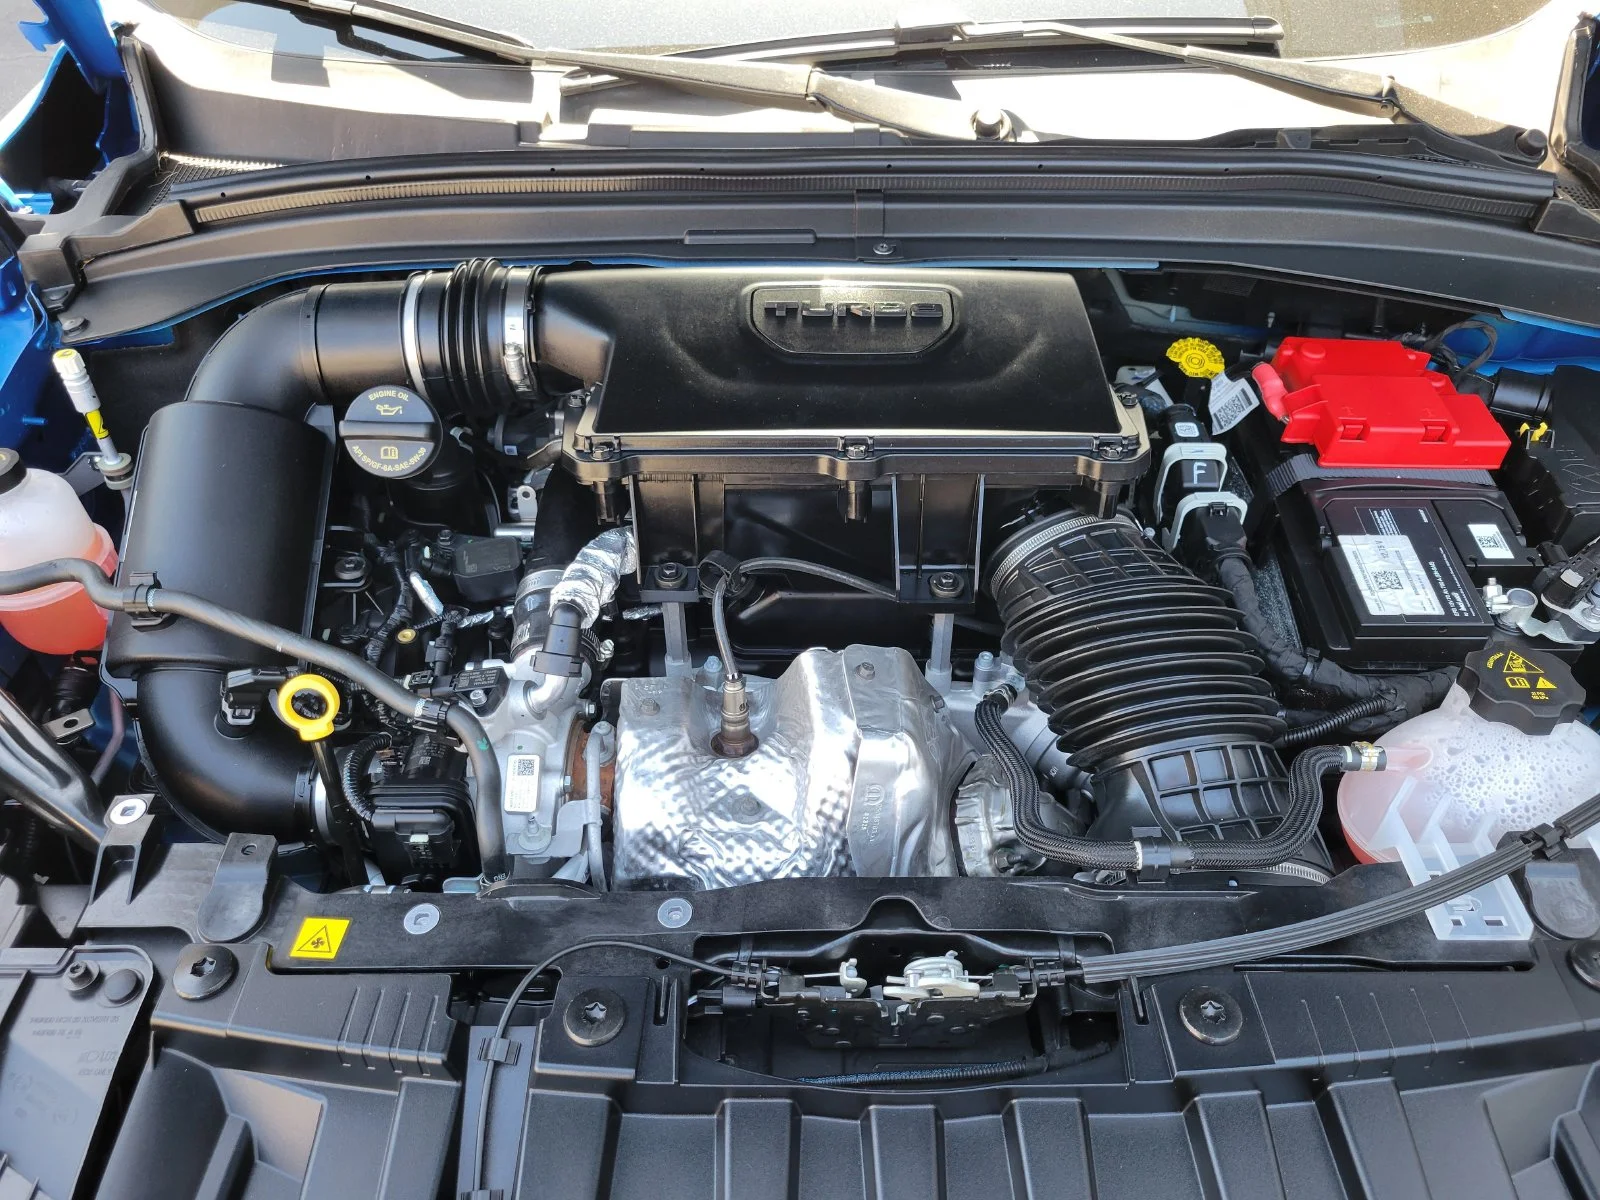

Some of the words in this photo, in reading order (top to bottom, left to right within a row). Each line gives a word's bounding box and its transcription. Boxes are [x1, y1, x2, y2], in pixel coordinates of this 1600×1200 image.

[764, 300, 943, 317] TURBO
[368, 390, 397, 401] ENGINE
[397, 391, 409, 402] OIL
[1193, 461, 1207, 485] F
